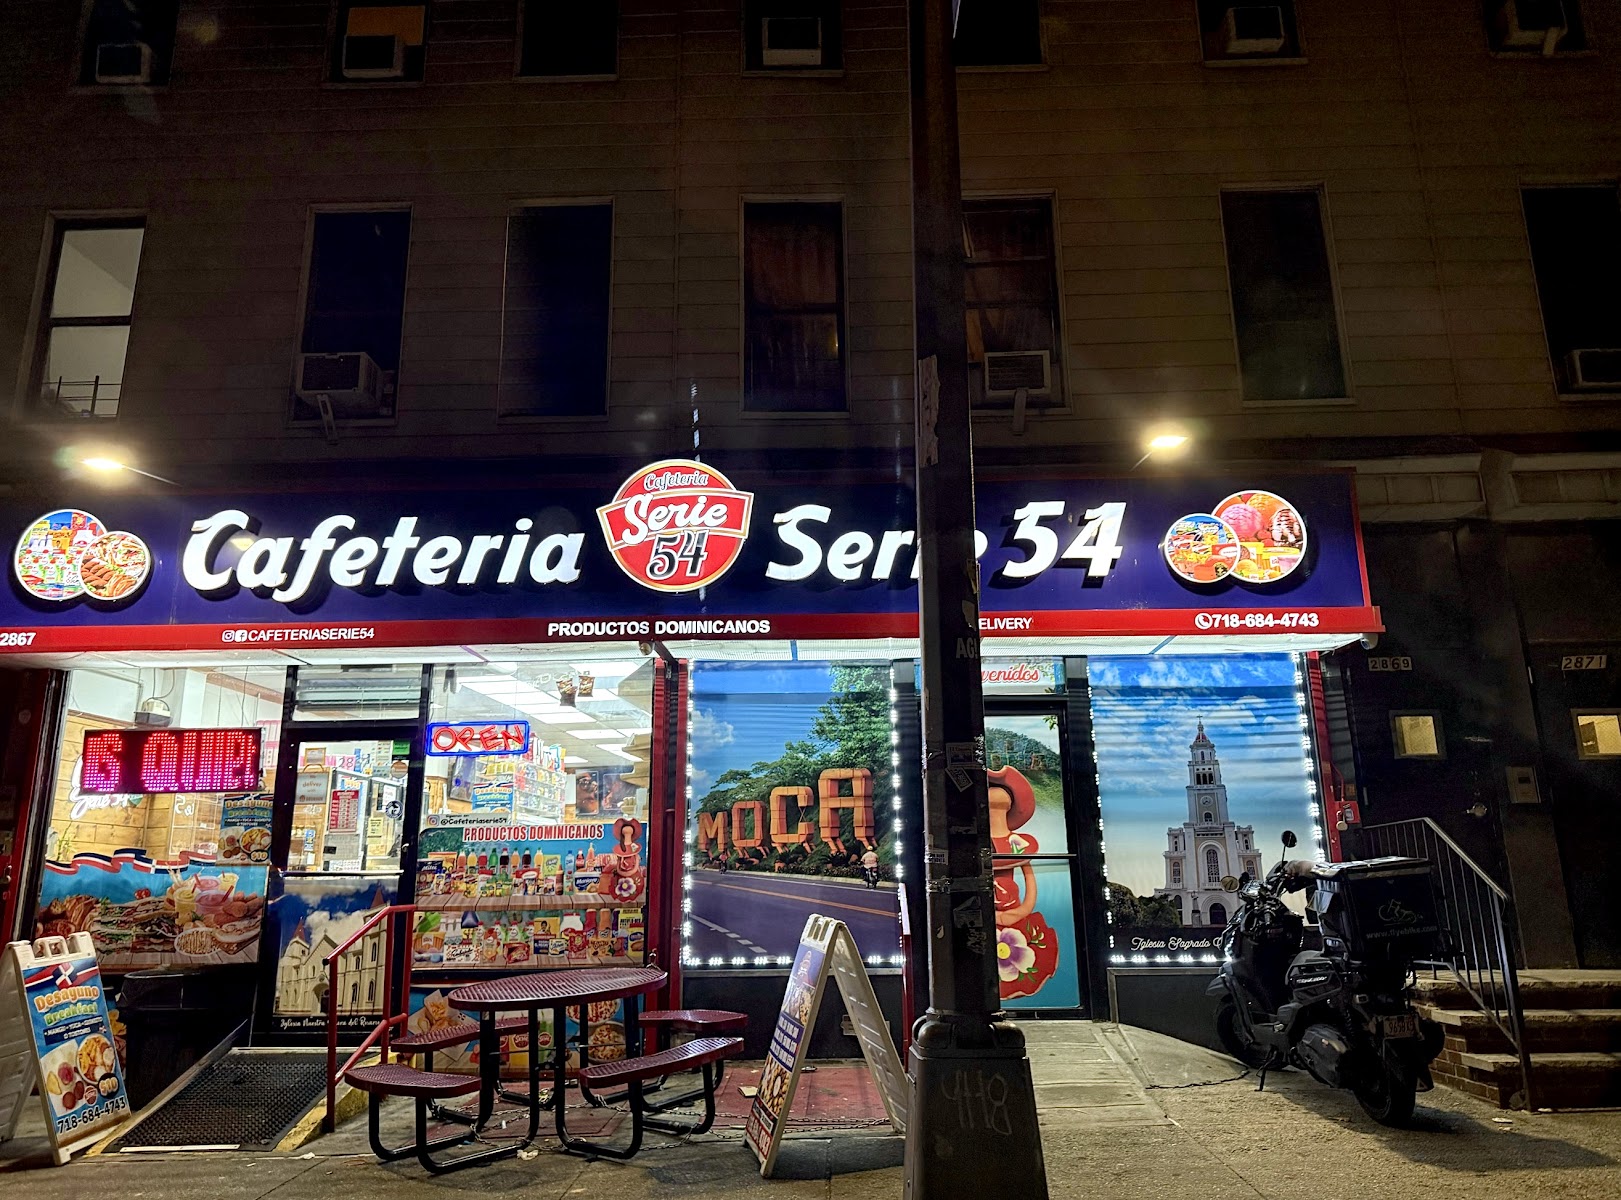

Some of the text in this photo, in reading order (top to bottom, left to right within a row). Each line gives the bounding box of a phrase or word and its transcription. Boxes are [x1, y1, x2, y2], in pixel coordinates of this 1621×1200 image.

[644, 470, 709, 490] Cafeteria
[622, 493, 728, 545] Serie
[182, 500, 1127, 602] Cafeteria Ser 54
[646, 529, 710, 580] 54
[547, 619, 771, 637] PRODUCTOS DOMINICANOS
[979, 616, 1033, 631] ELIVERY
[1211, 612, 1319, 628] 718-684-4743
[0, 632, 36, 647] 2867
[247, 627, 375, 642] CAFETERIASERIE54
[1369, 657, 1411, 670] 2869
[1562, 655, 1606, 670] 2871
[432, 724, 525, 752] OPEN
[697, 767, 877, 857] MOCA
[463, 823, 604, 842] PRODUCTOS DOMINICANOS
[1130, 936, 1166, 951] Iglesia
[1167, 936, 1211, 951] Sagrado
[56, 1097, 126, 1133] 718-684-4743
